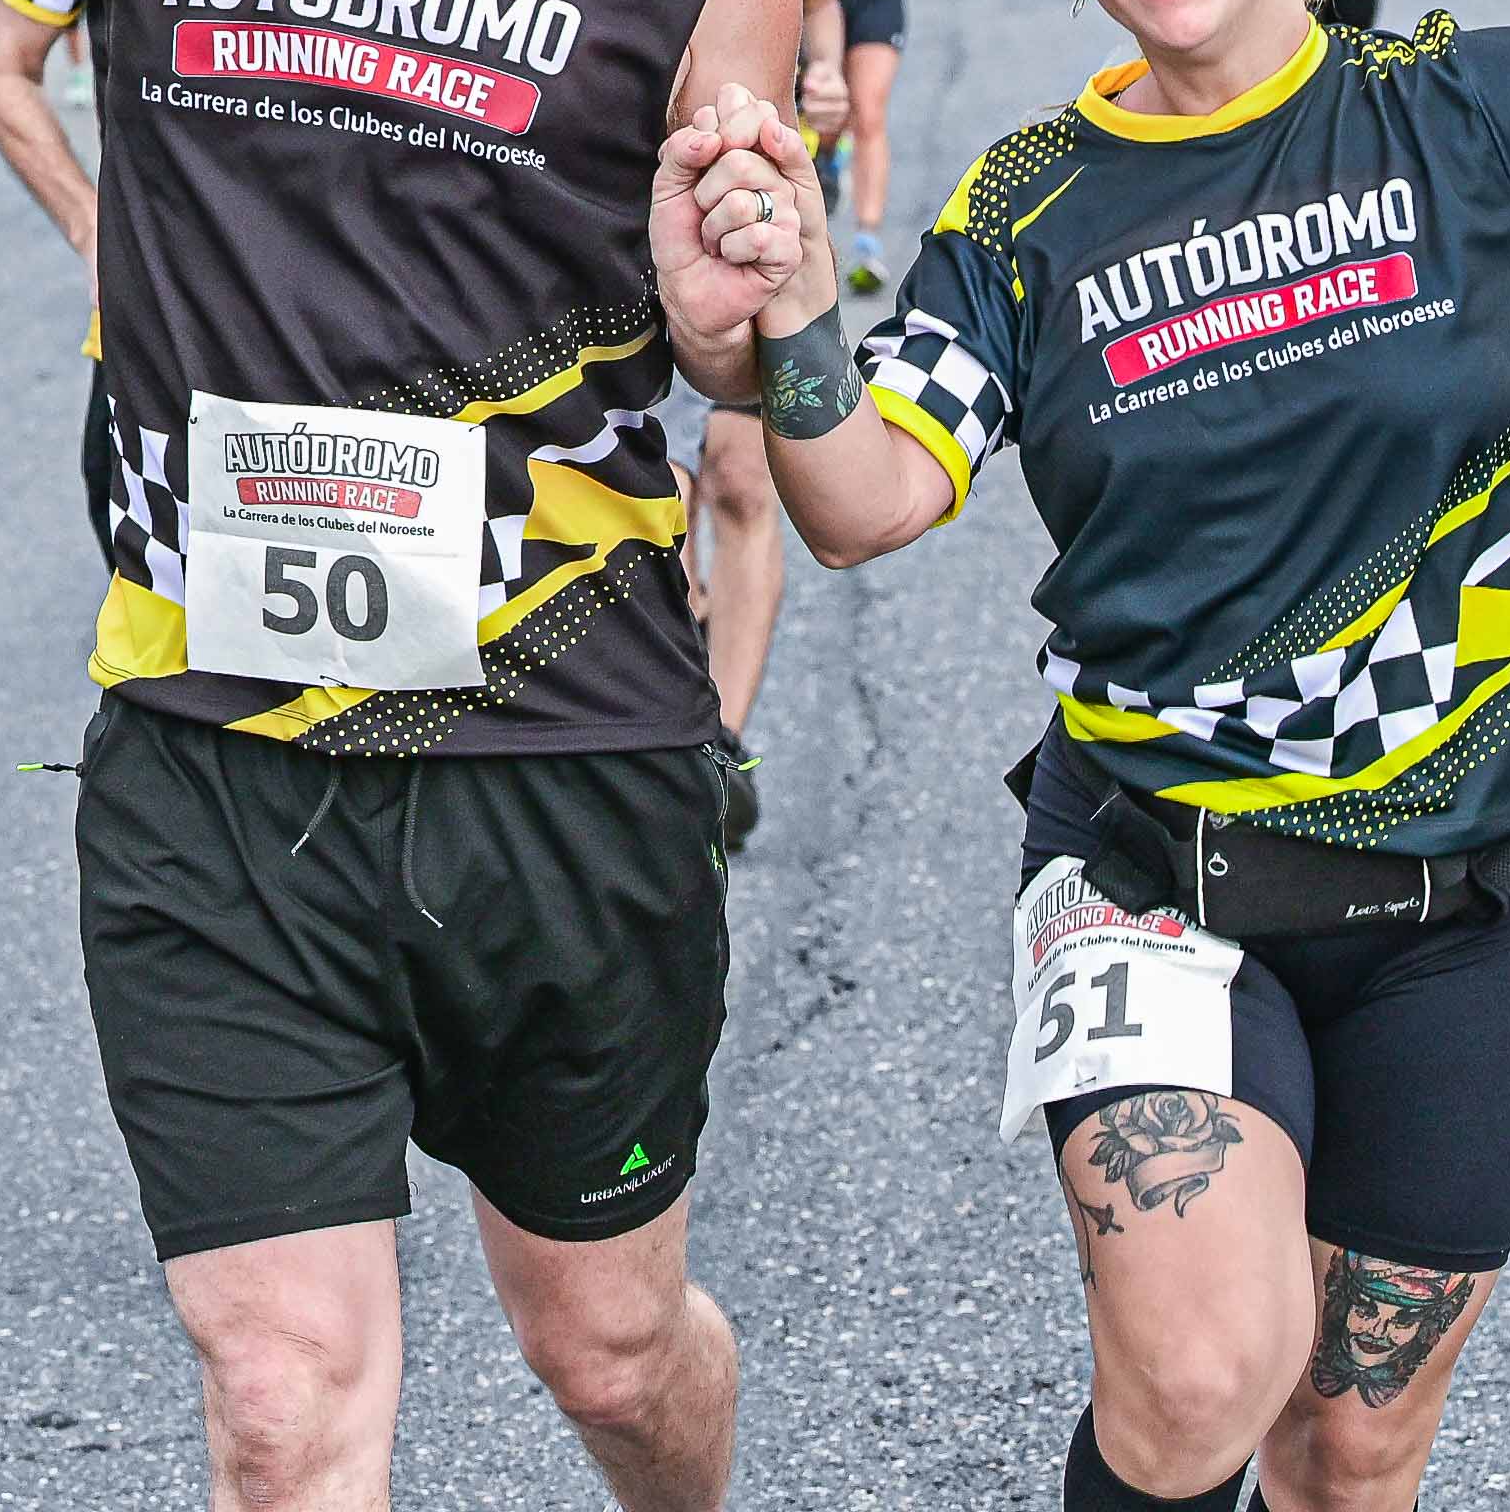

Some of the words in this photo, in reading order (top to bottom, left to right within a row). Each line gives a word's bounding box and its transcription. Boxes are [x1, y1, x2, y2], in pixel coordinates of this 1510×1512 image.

[212, 29, 380, 85] RUNNING
[386, 55, 496, 118] RACE
[141, 77, 162, 102] La
[167, 82, 248, 117] Carrera
[255, 96, 285, 121] de
[291, 99, 324, 126] los
[329, 106, 403, 142] Clubes
[408, 123, 445, 150] del
[452, 131, 546, 171] Noroeste
[1075, 177, 1418, 344] AUTÓDROMO
[1088, 401, 1111, 425] La
[1114, 377, 1189, 415] Carrera
[1193, 367, 1219, 392] de
[1222, 357, 1252, 382] los
[1255, 337, 1324, 372] Clubes
[1328, 325, 1361, 351] del
[1365, 296, 1456, 339] Noroeste
[1138, 296, 1286, 371] RUNNING
[1293, 267, 1380, 321] RACE
[225, 422, 439, 488] AUTÓDROMO
[255, 481, 339, 503] RUNNING
[345, 485, 398, 513] RACE
[223, 506, 236, 518] La
[239, 508, 279, 524] Carrera
[281, 513, 297, 526] de
[298, 513, 315, 527] los
[317, 517, 355, 532] Clubes
[357, 520, 376, 533] del
[379, 522, 435, 537] Noroeste
[262, 545, 389, 642] 50
[1040, 906, 1106, 955] RUNNING
[1111, 907, 1163, 932] RACE
[1063, 939, 1077, 954] los
[1079, 933, 1117, 949] Clubes
[1120, 934, 1140, 947] del
[1142, 938, 1196, 955] Noroeste
[1034, 962, 1142, 1063] 51
